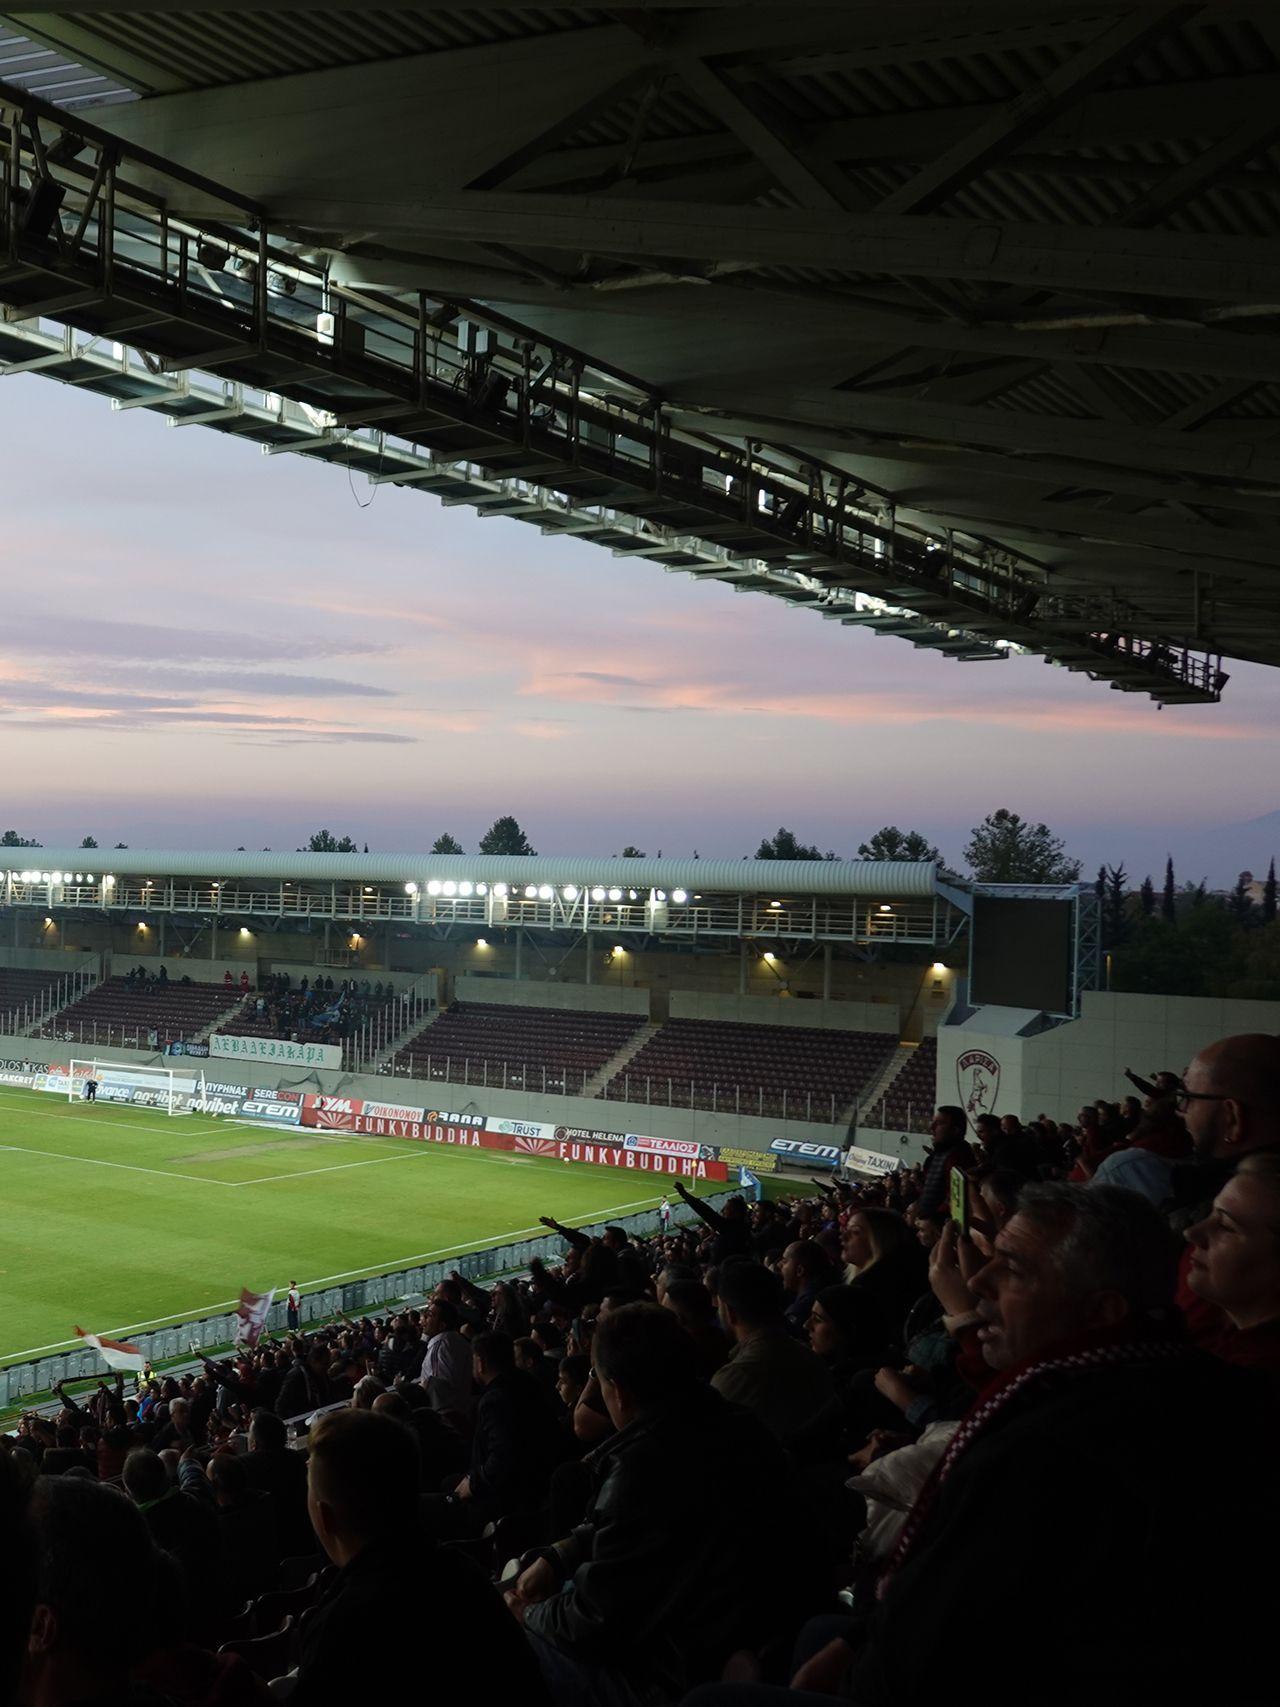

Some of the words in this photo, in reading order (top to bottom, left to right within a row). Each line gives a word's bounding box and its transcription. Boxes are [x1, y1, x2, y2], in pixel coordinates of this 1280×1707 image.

[241, 1101, 299, 1118] ETEM
[355, 1116, 480, 1147] FUNKYBUDDHA
[511, 1121, 542, 1137] TRUST
[592, 1131, 625, 1143] HELENA
[650, 1138, 694, 1154] ΤΕΛΛΙΟΣ
[770, 1138, 840, 1159] ETEM
[559, 1142, 707, 1178] FUNKYBUDDHA
